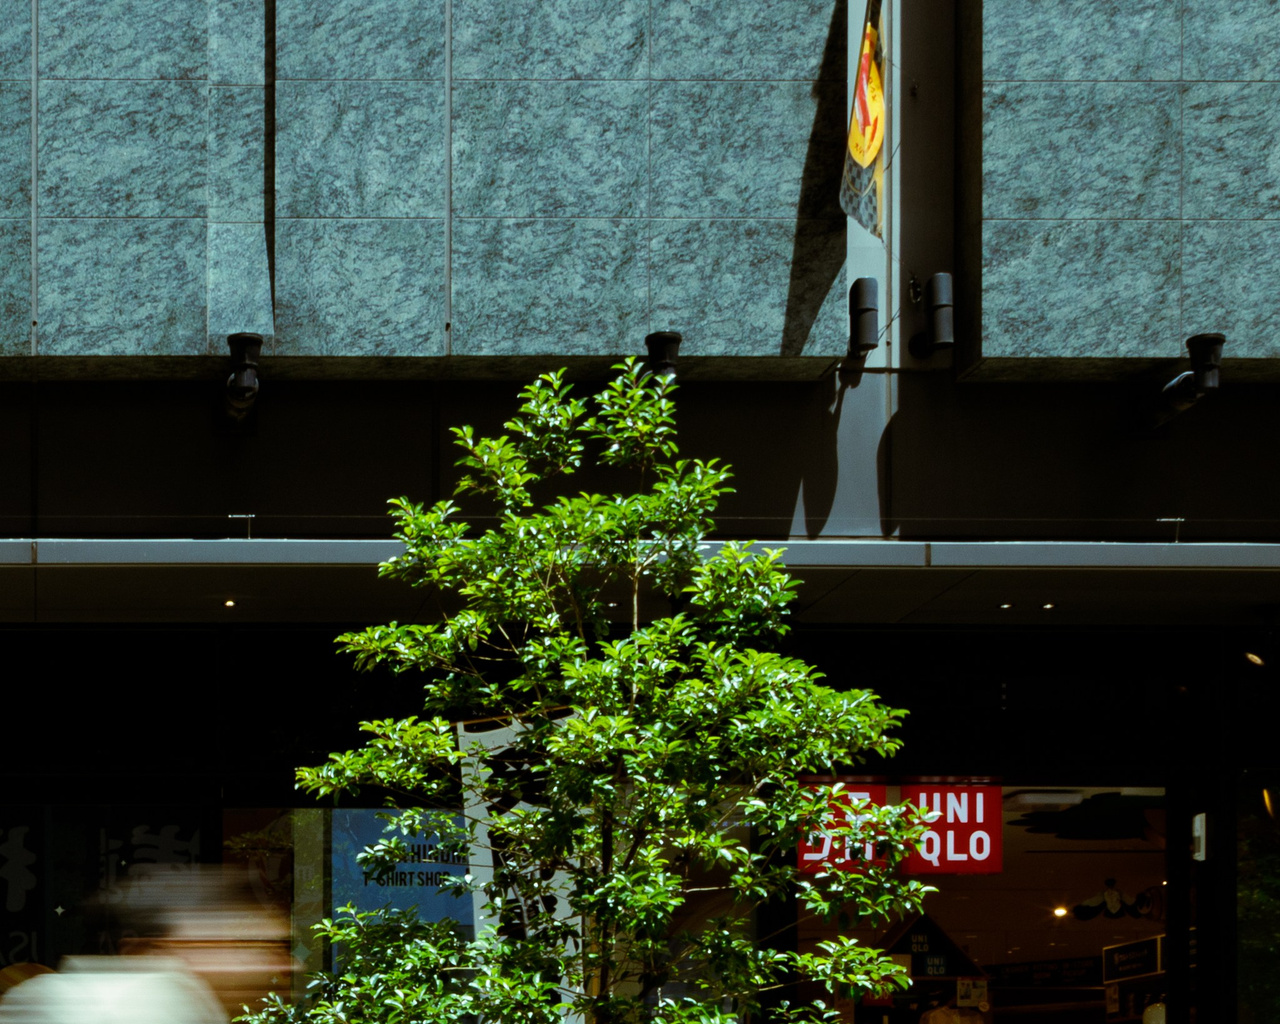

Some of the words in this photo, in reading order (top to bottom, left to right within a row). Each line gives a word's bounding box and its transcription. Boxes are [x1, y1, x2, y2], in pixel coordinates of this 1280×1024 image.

[919, 792, 984, 824] UNI
[920, 830, 991, 867] QLO
[363, 872, 415, 887] T-SHIRT
[911, 934, 927, 943] UNI
[911, 944, 928, 954] QLO
[927, 957, 943, 966] UNI
[927, 966, 945, 976] QLO
